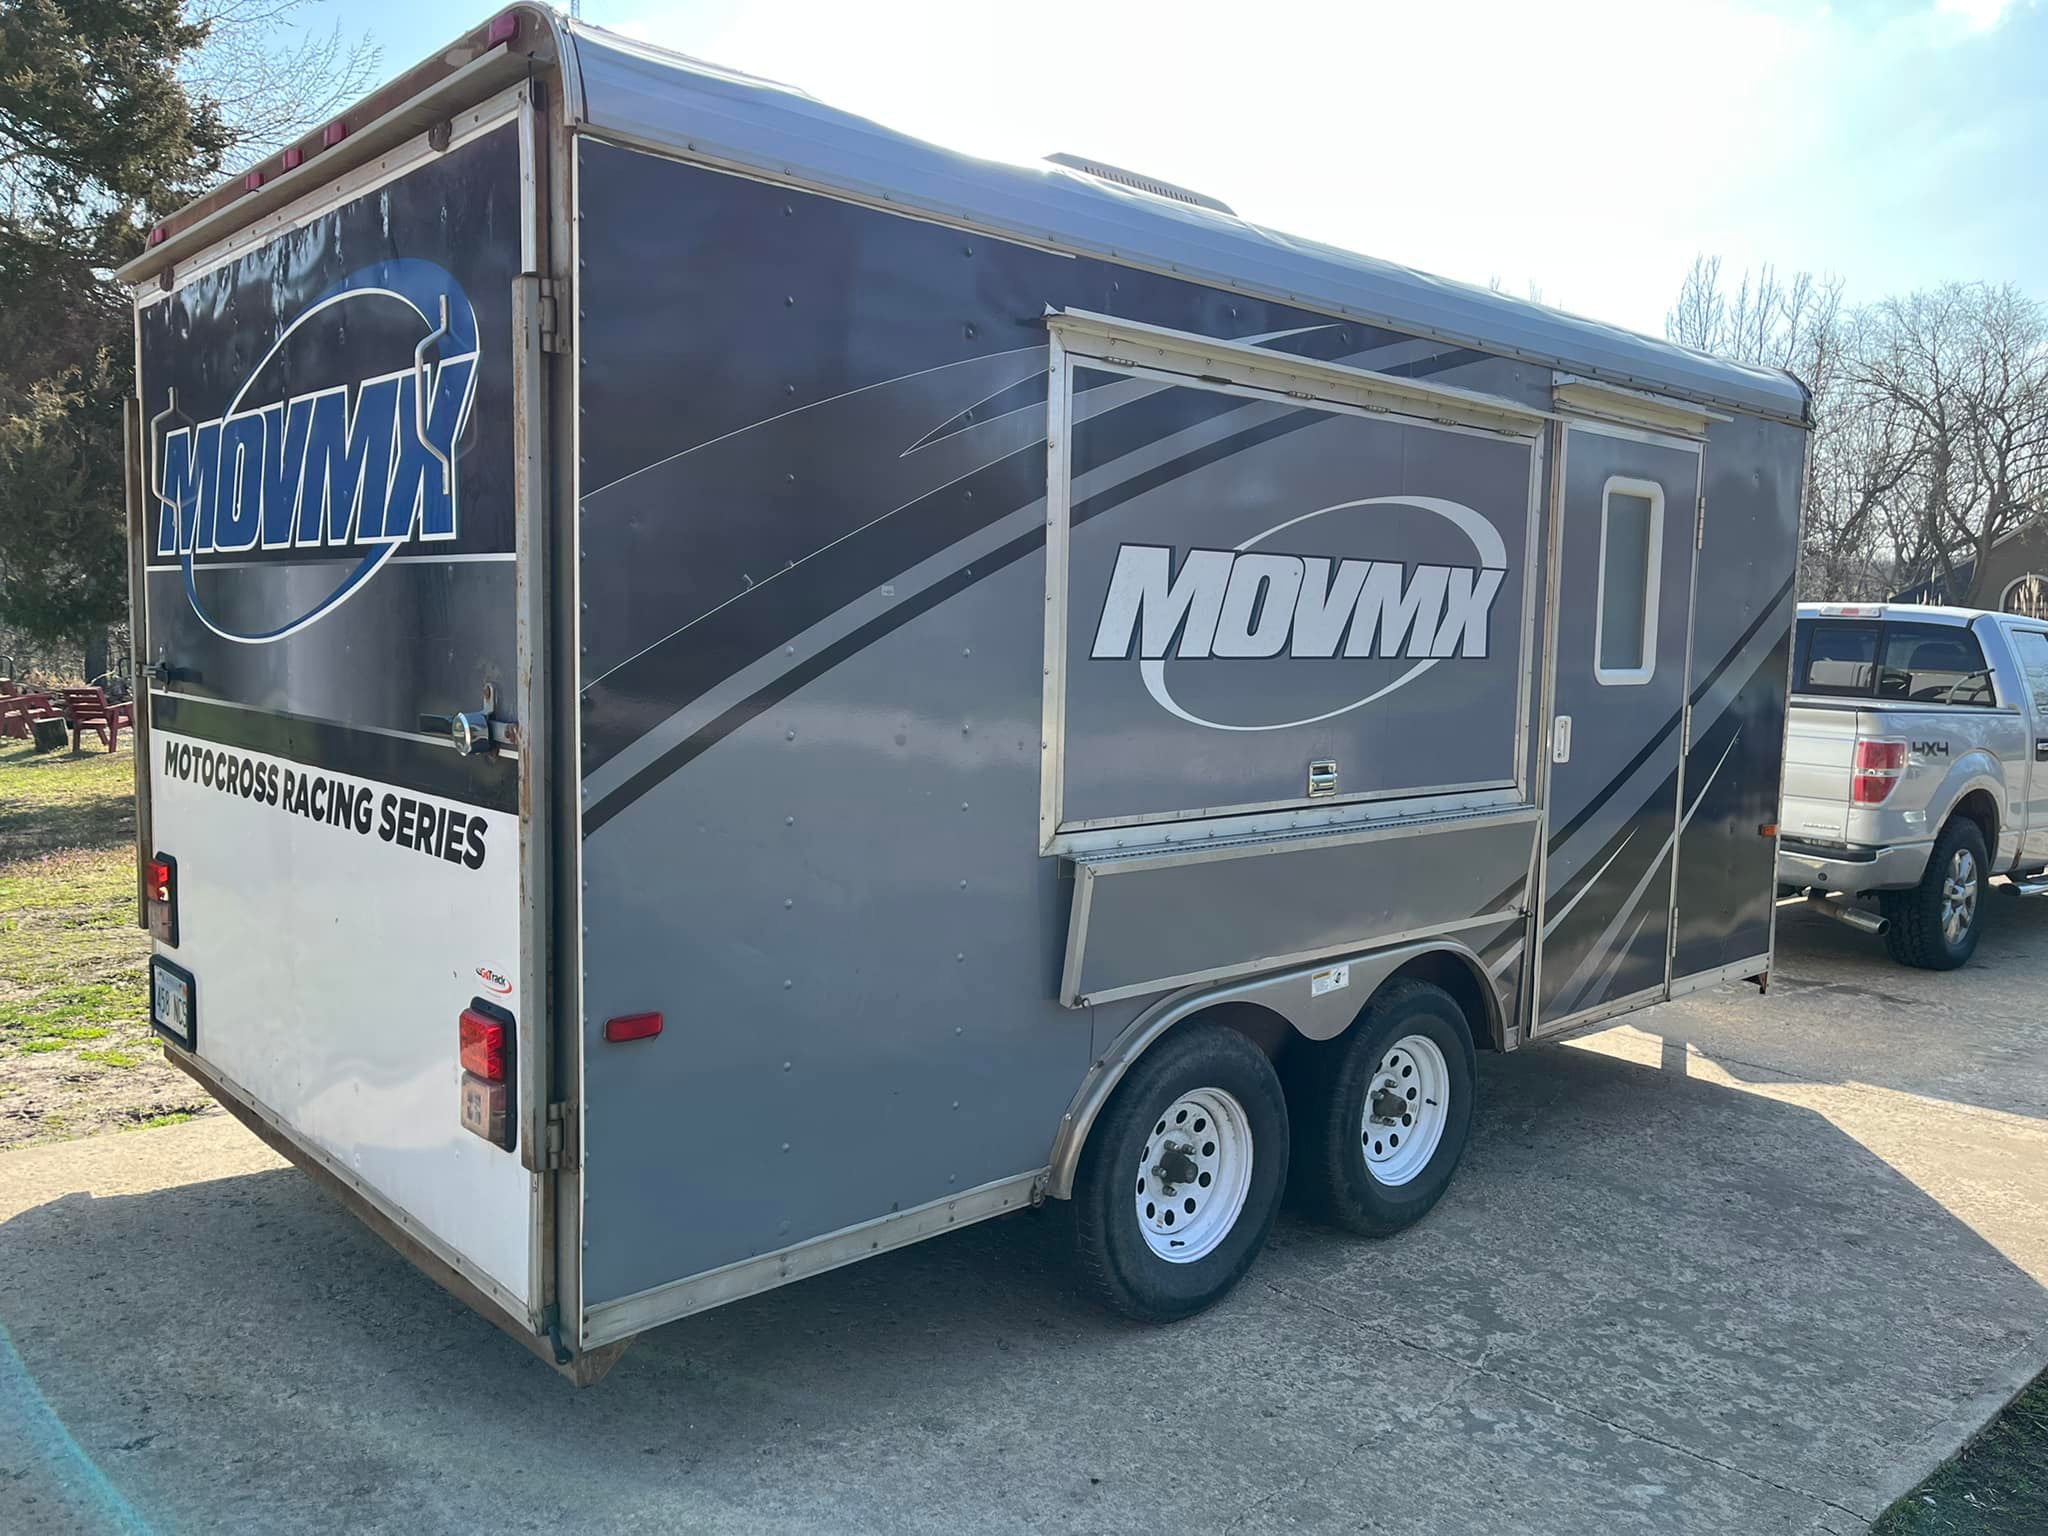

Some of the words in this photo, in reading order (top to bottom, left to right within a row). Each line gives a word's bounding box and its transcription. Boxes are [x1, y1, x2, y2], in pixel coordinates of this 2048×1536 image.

[157, 350, 480, 556] MOVMX
[1088, 541, 1508, 661] MOVMX
[164, 741, 279, 806] MOTOCROSS
[282, 768, 373, 834] RACING
[378, 793, 488, 870] SERIES
